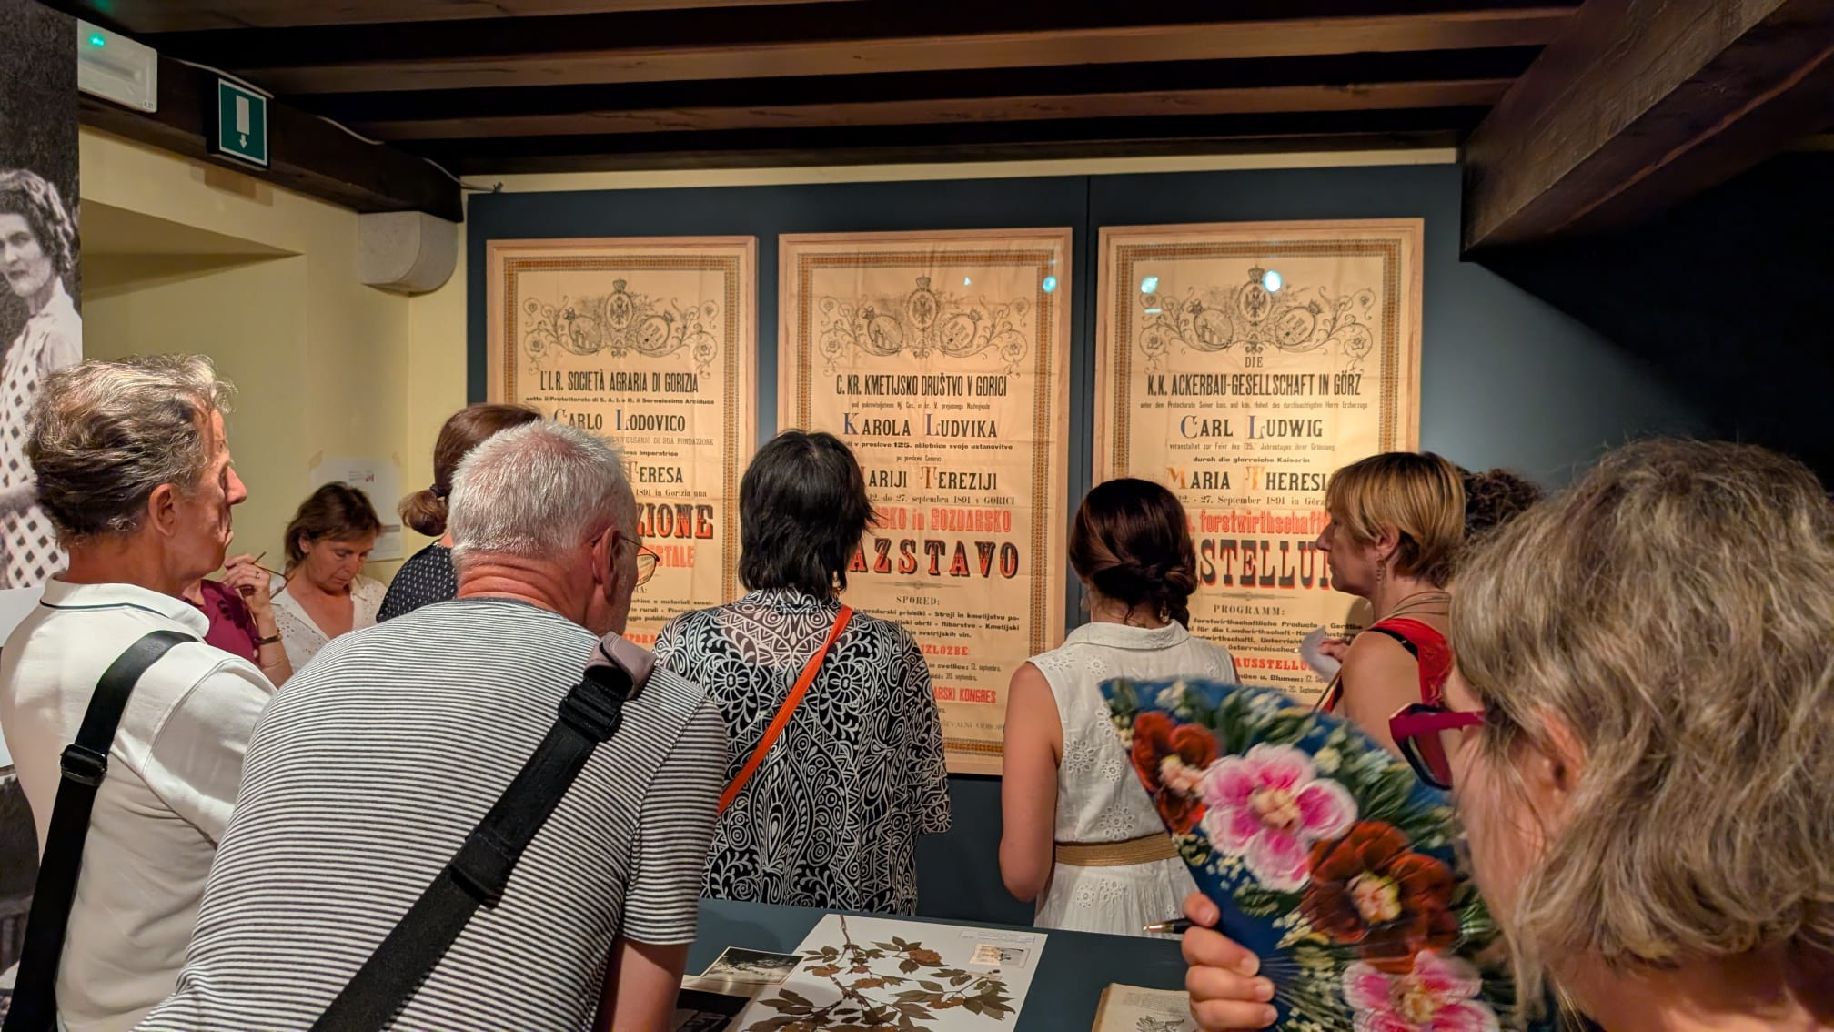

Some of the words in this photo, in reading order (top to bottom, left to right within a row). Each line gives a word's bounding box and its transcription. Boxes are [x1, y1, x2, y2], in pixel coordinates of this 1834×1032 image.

[1244, 356, 1264, 368] DIE
[568, 368, 605, 392] SOCIETÀ
[609, 371, 648, 392] AGRARIA
[652, 371, 661, 393] DI
[664, 372, 699, 393] GORIZIA
[836, 374, 845, 395] C.
[847, 374, 862, 396] KR.
[864, 374, 919, 396] KMETIJSKO
[921, 372, 963, 397] DRUŠTVO
[967, 375, 973, 397] V
[976, 375, 1007, 397] GORICI
[1171, 373, 1316, 396] ACKERBAU-GESELLSCHAFT
[1318, 373, 1330, 396] IN
[1333, 370, 1362, 396] GÖRZ
[554, 408, 603, 431] CARLO
[616, 408, 687, 432] LODOVICO
[843, 411, 912, 437] KAROLA
[925, 413, 998, 438] LUDVIKA
[1180, 414, 1234, 439] CARL
[1247, 415, 1323, 440] LUDWIG
[620, 460, 684, 484] TERESA
[861, 466, 907, 488] ARIJI
[920, 466, 997, 490] TEREZIJI
[1166, 466, 1231, 490] MARIA
[1245, 466, 1327, 492] THERESI
[875, 505, 907, 530] SKO
[931, 507, 1012, 533] GOZDARSKO
[849, 538, 1020, 580] AZSTAVO
[1199, 539, 1330, 590] STELLU
